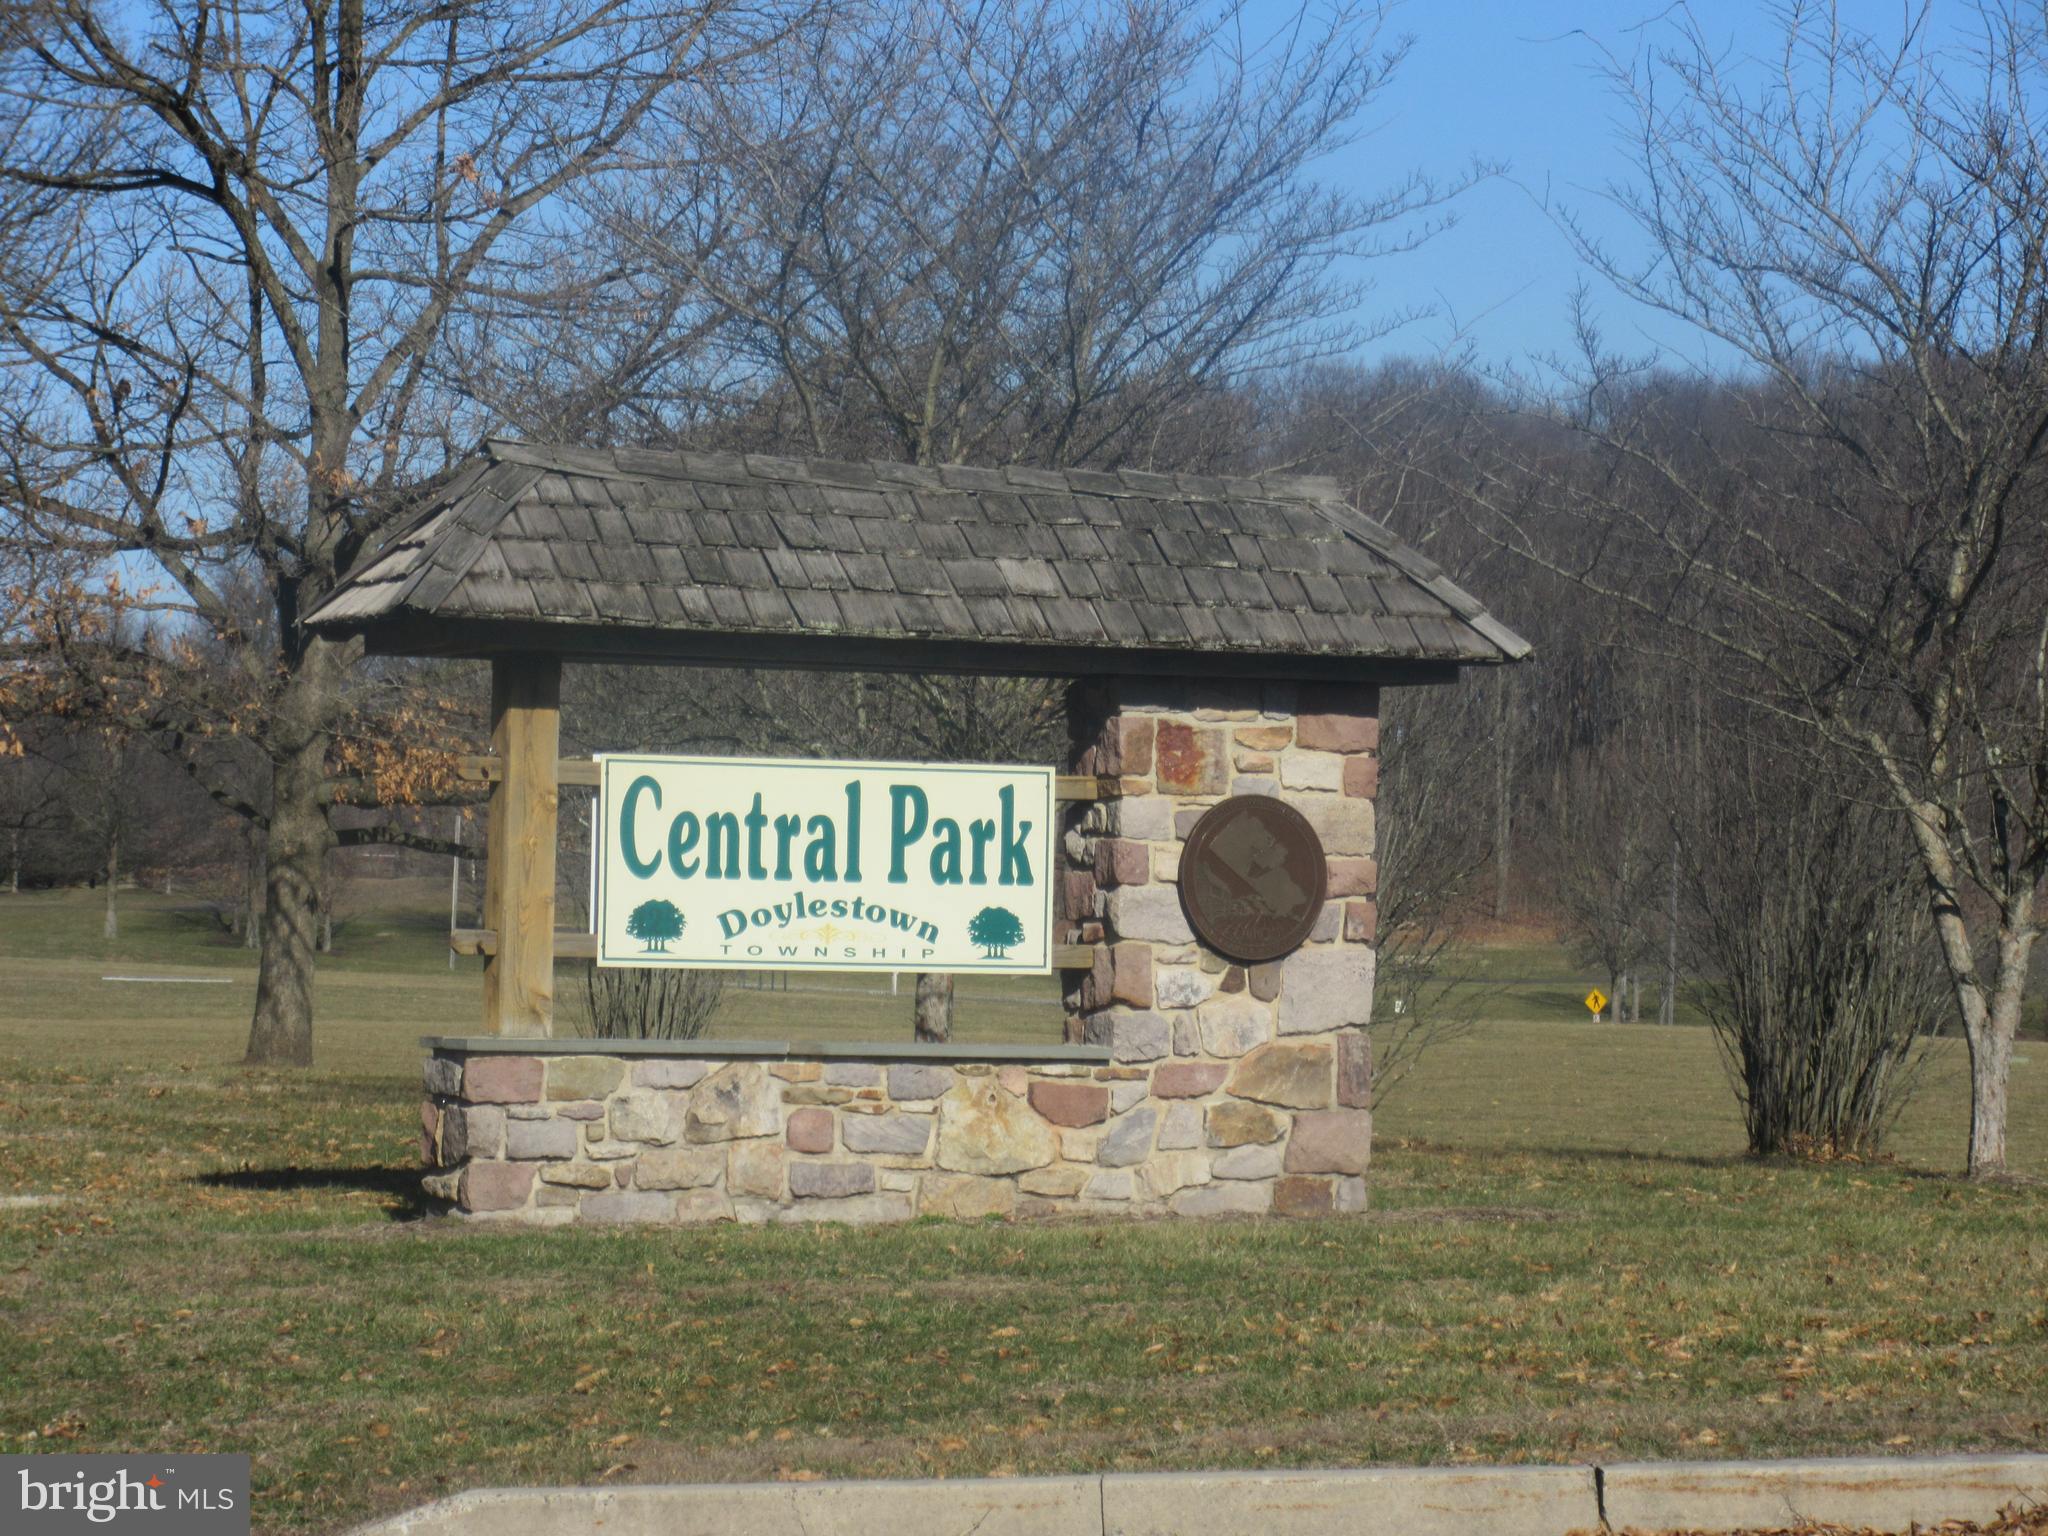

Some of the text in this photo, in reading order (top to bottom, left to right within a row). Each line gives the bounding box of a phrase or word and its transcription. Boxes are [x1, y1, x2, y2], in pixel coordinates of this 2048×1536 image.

[619, 775, 1034, 886] Central Park
[716, 891, 940, 945] Doylestown
[719, 944, 936, 959] TOWNSHIP
